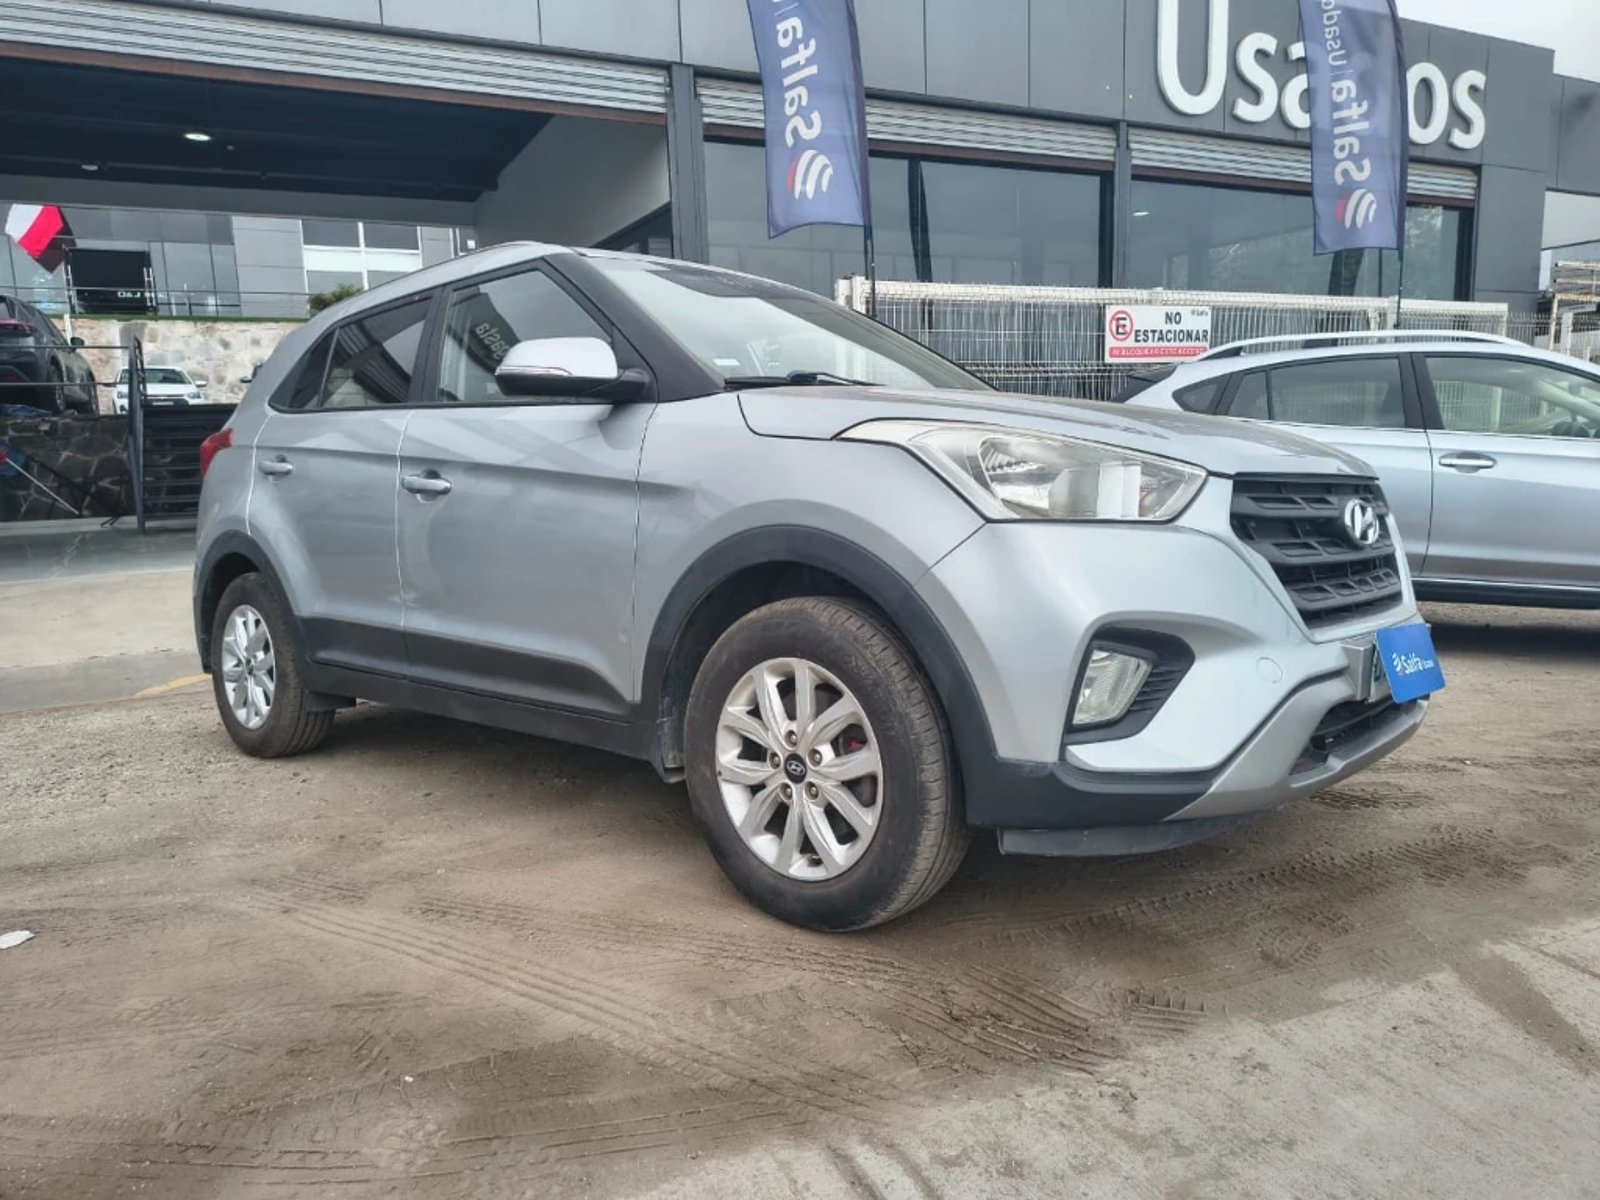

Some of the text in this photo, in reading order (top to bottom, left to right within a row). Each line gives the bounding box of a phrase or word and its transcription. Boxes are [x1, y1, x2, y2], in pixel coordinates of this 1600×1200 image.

[1157, 0, 1487, 150] Usaos
[1165, 311, 1182, 325] NO
[1134, 329, 1209, 343] ESTACIONAR
